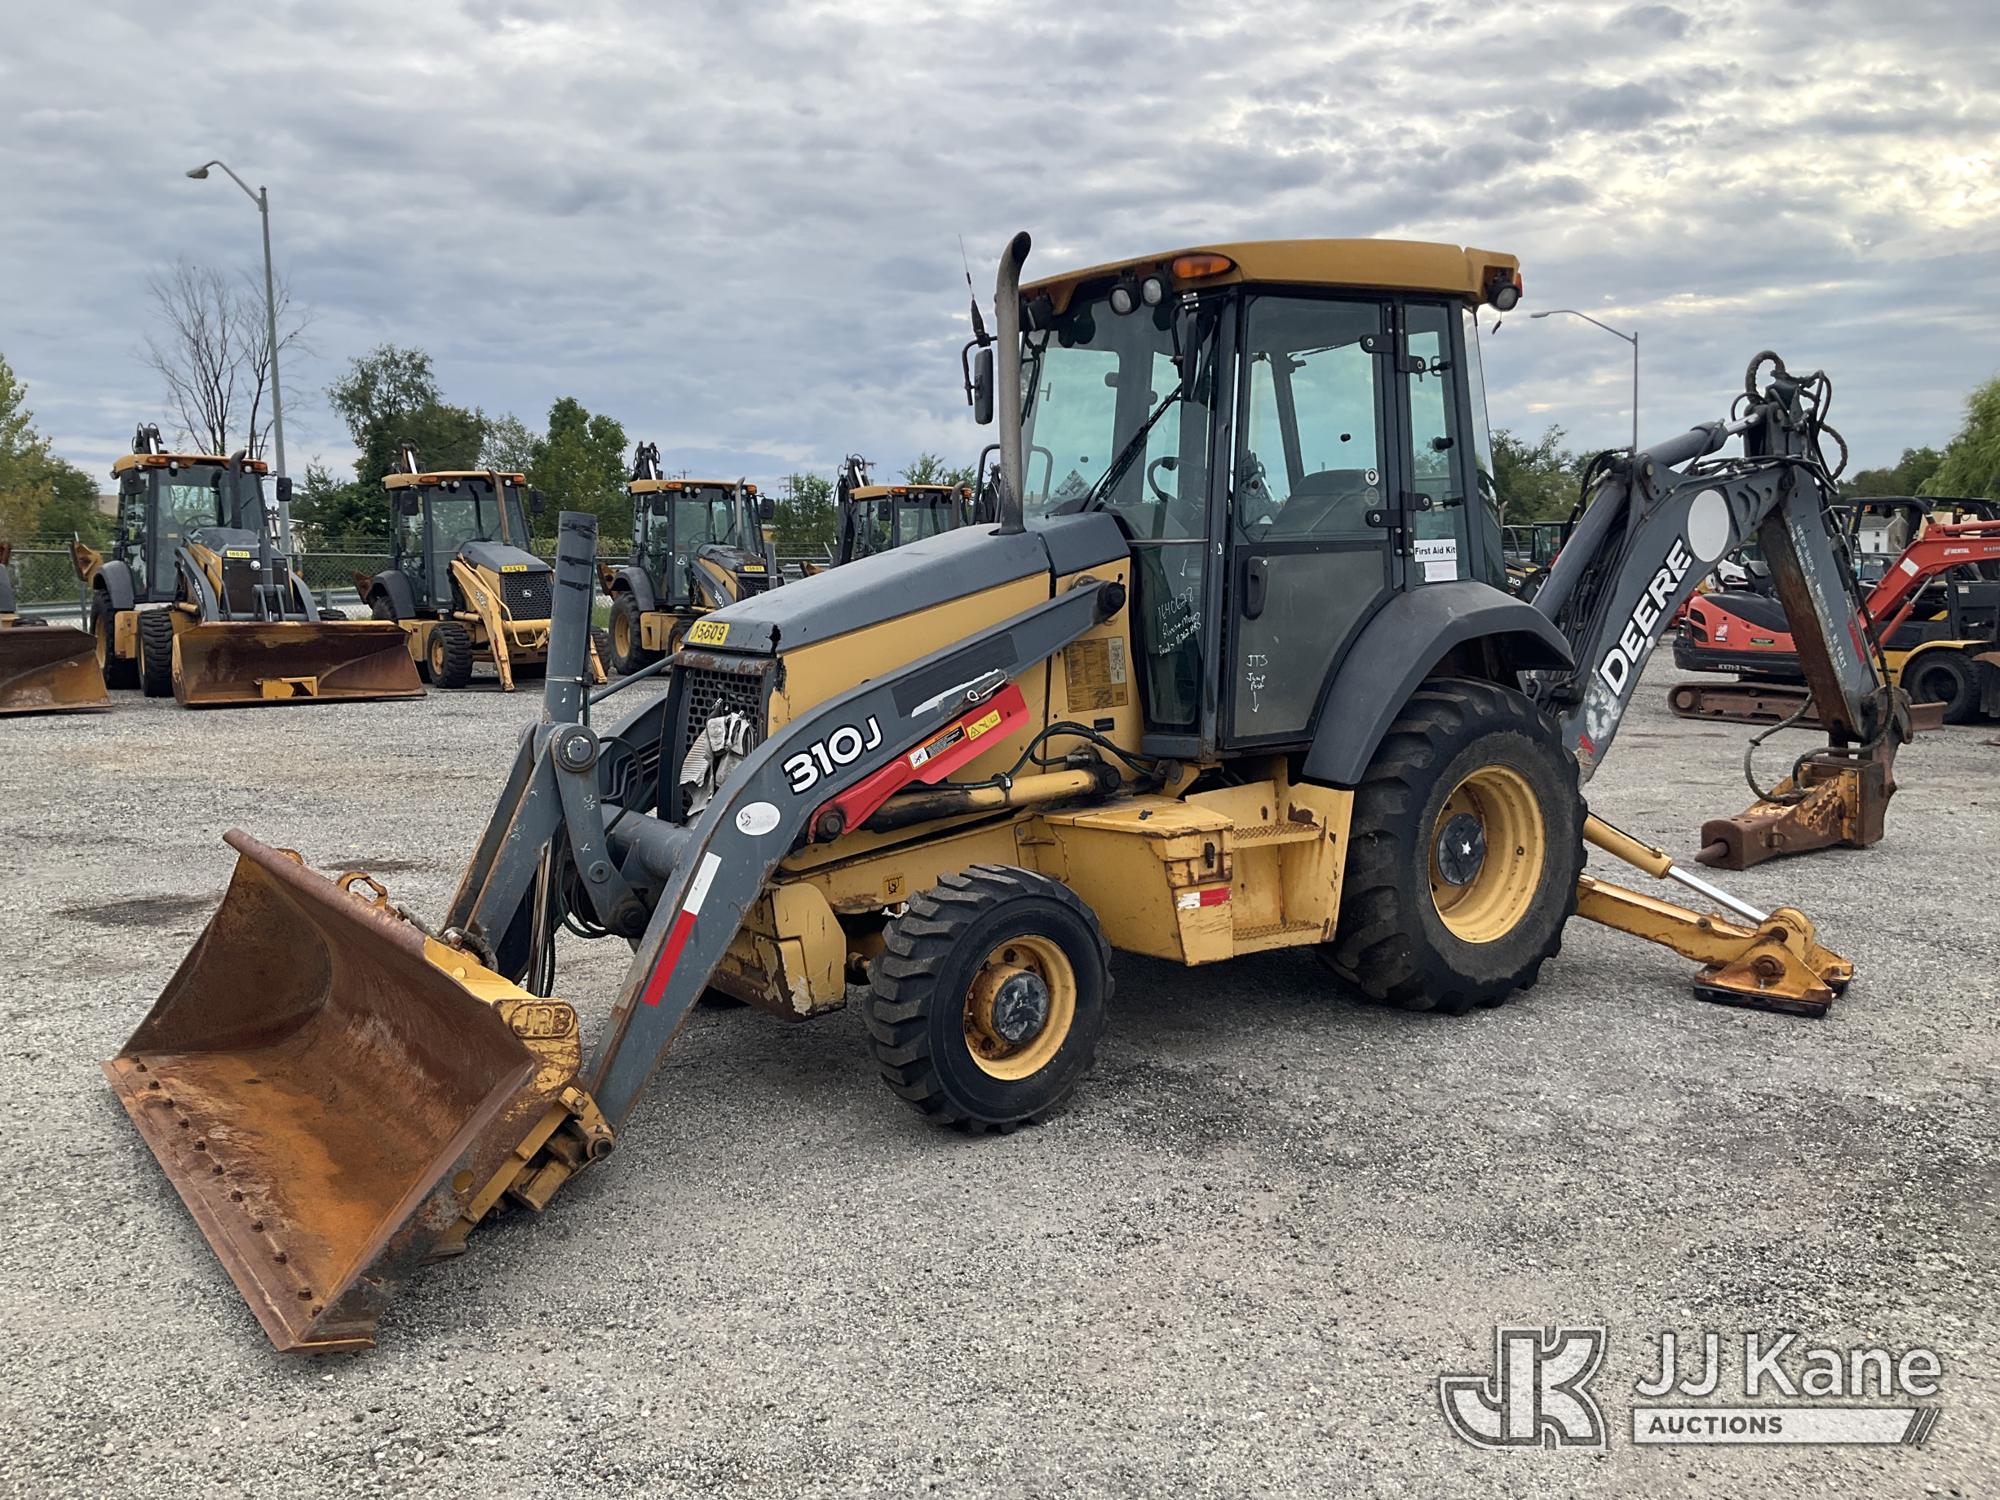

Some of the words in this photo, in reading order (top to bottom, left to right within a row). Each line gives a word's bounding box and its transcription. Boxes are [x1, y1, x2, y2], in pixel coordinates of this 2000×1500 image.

[1415, 546, 1431, 555] First
[1432, 546, 1444, 555] Aid
[1445, 545, 1456, 554] Kit
[692, 622, 726, 641] 15609
[1598, 536, 1694, 698] DEERE
[782, 715, 883, 795] 310J
